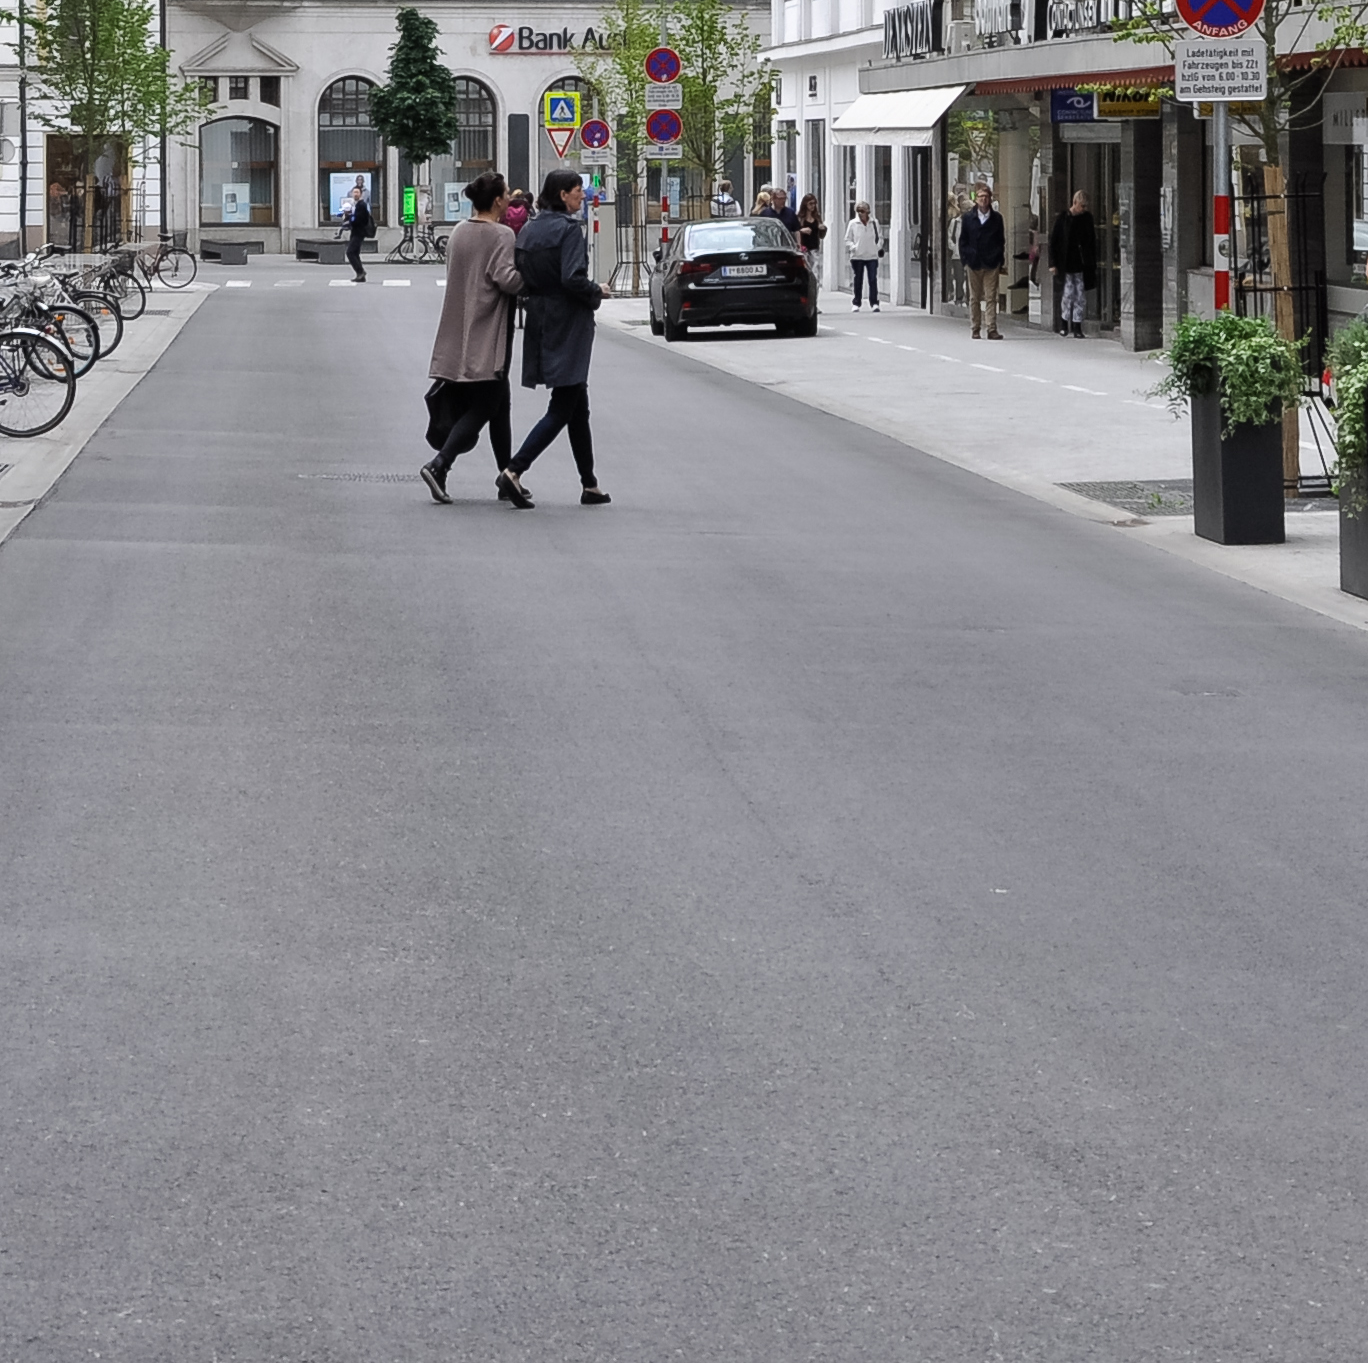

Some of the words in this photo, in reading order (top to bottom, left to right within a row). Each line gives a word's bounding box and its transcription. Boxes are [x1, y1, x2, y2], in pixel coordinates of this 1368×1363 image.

[1192, 18, 1248, 37] ANFANG
[518, 26, 576, 51] Bank
[1240, 47, 1254, 57] mit
[1182, 60, 1229, 72] Fahrzeugen
[1231, 59, 1244, 70] bis
[1201, 73, 1216, 82] von
[1179, 86, 1191, 94] am
[1192, 83, 1226, 96] Gehsteig
[1227, 83, 1263, 96] gestattet
